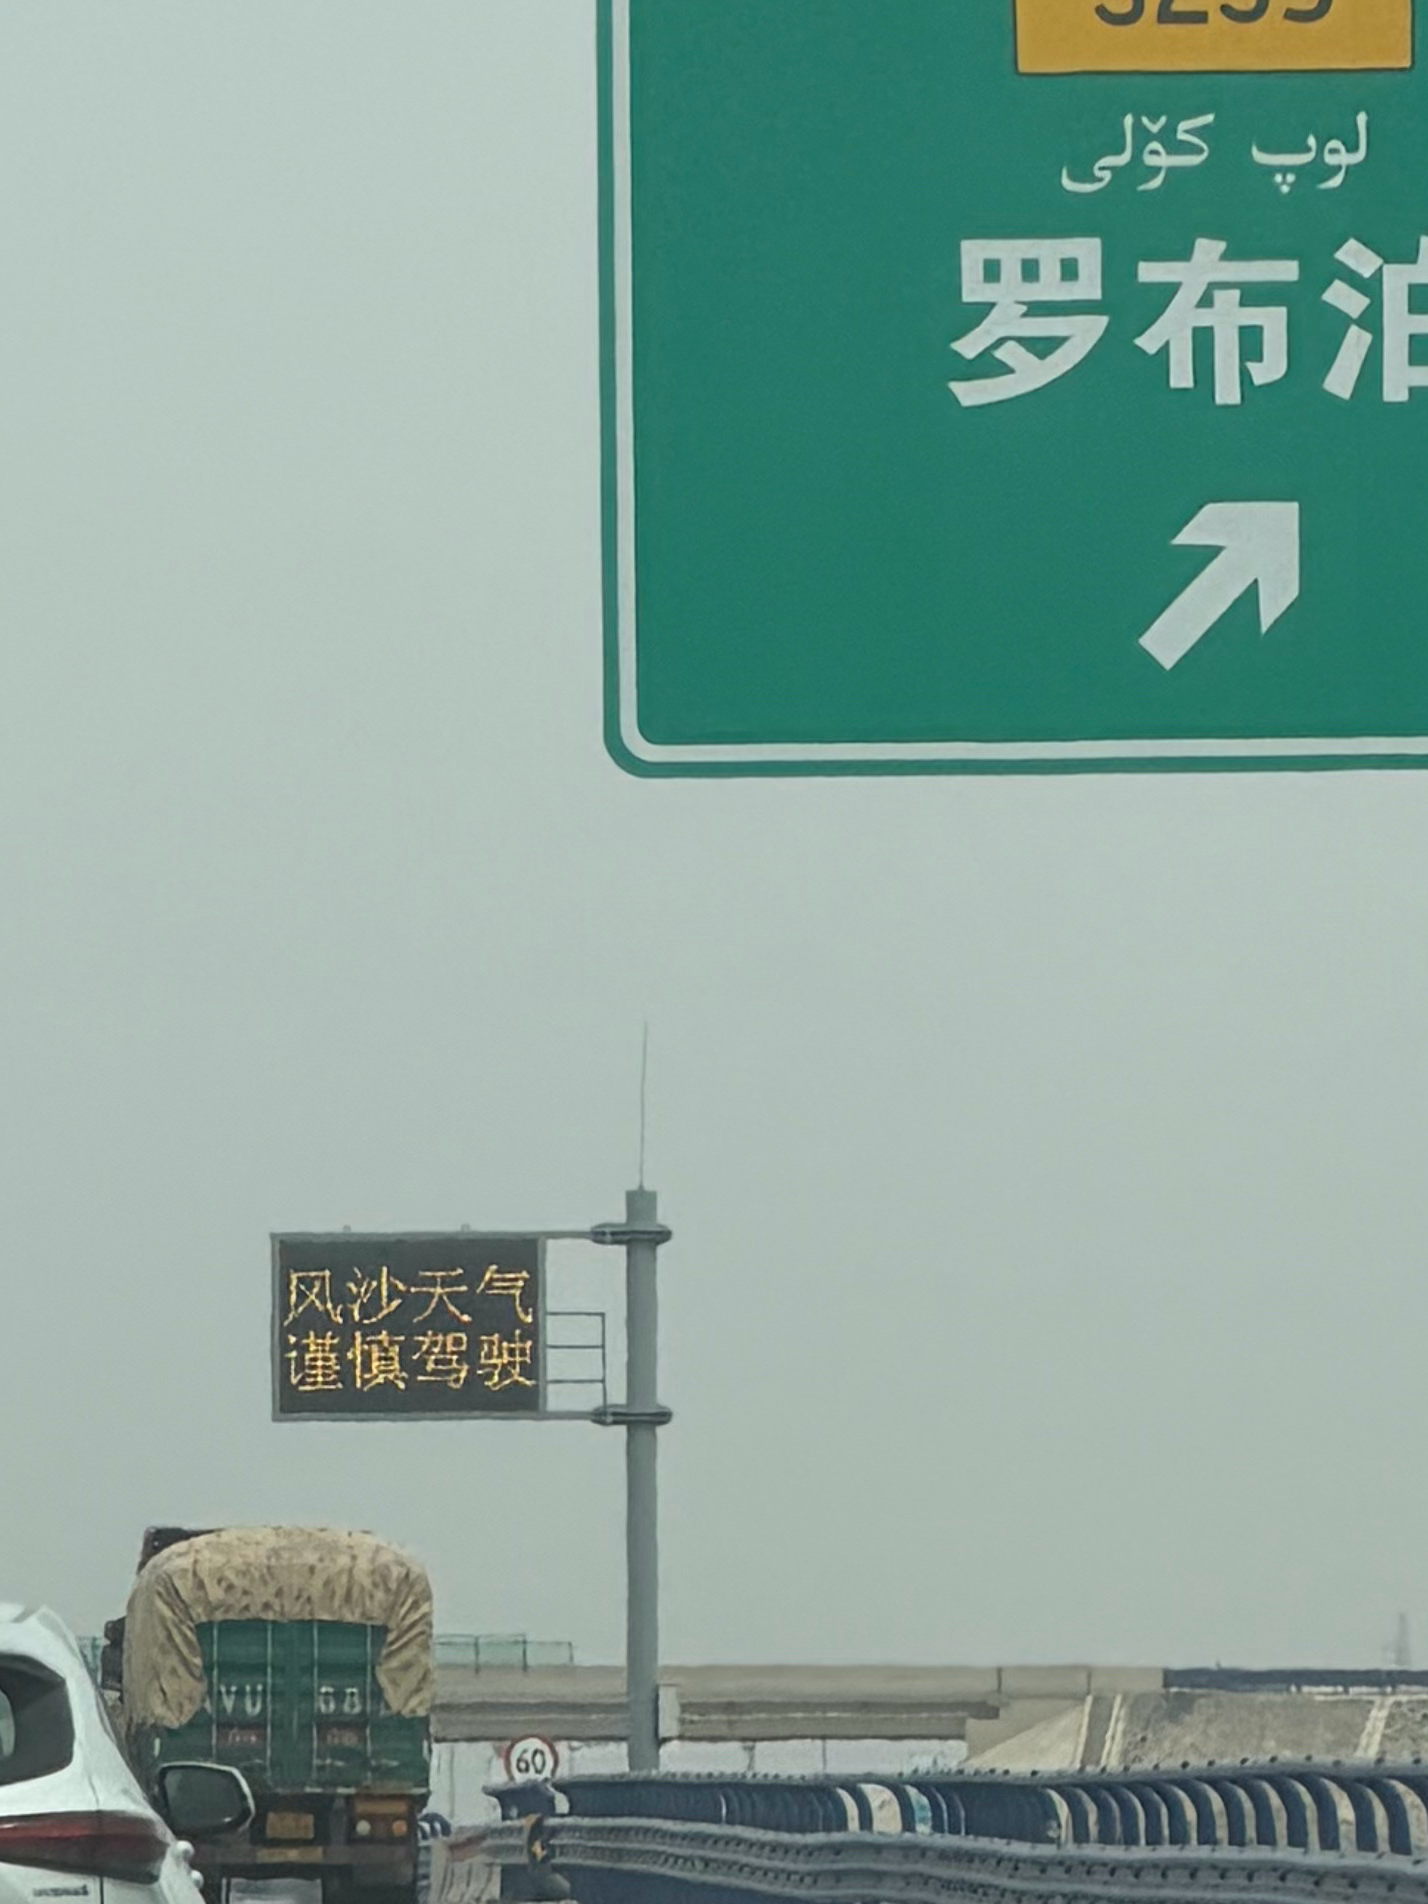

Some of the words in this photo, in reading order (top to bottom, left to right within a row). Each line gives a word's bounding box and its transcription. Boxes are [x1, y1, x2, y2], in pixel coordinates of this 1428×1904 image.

[283, 1264, 533, 1327] 风沙天气
[285, 1329, 537, 1391] 谨慎驾驶
[516, 1748, 546, 1775] 60
